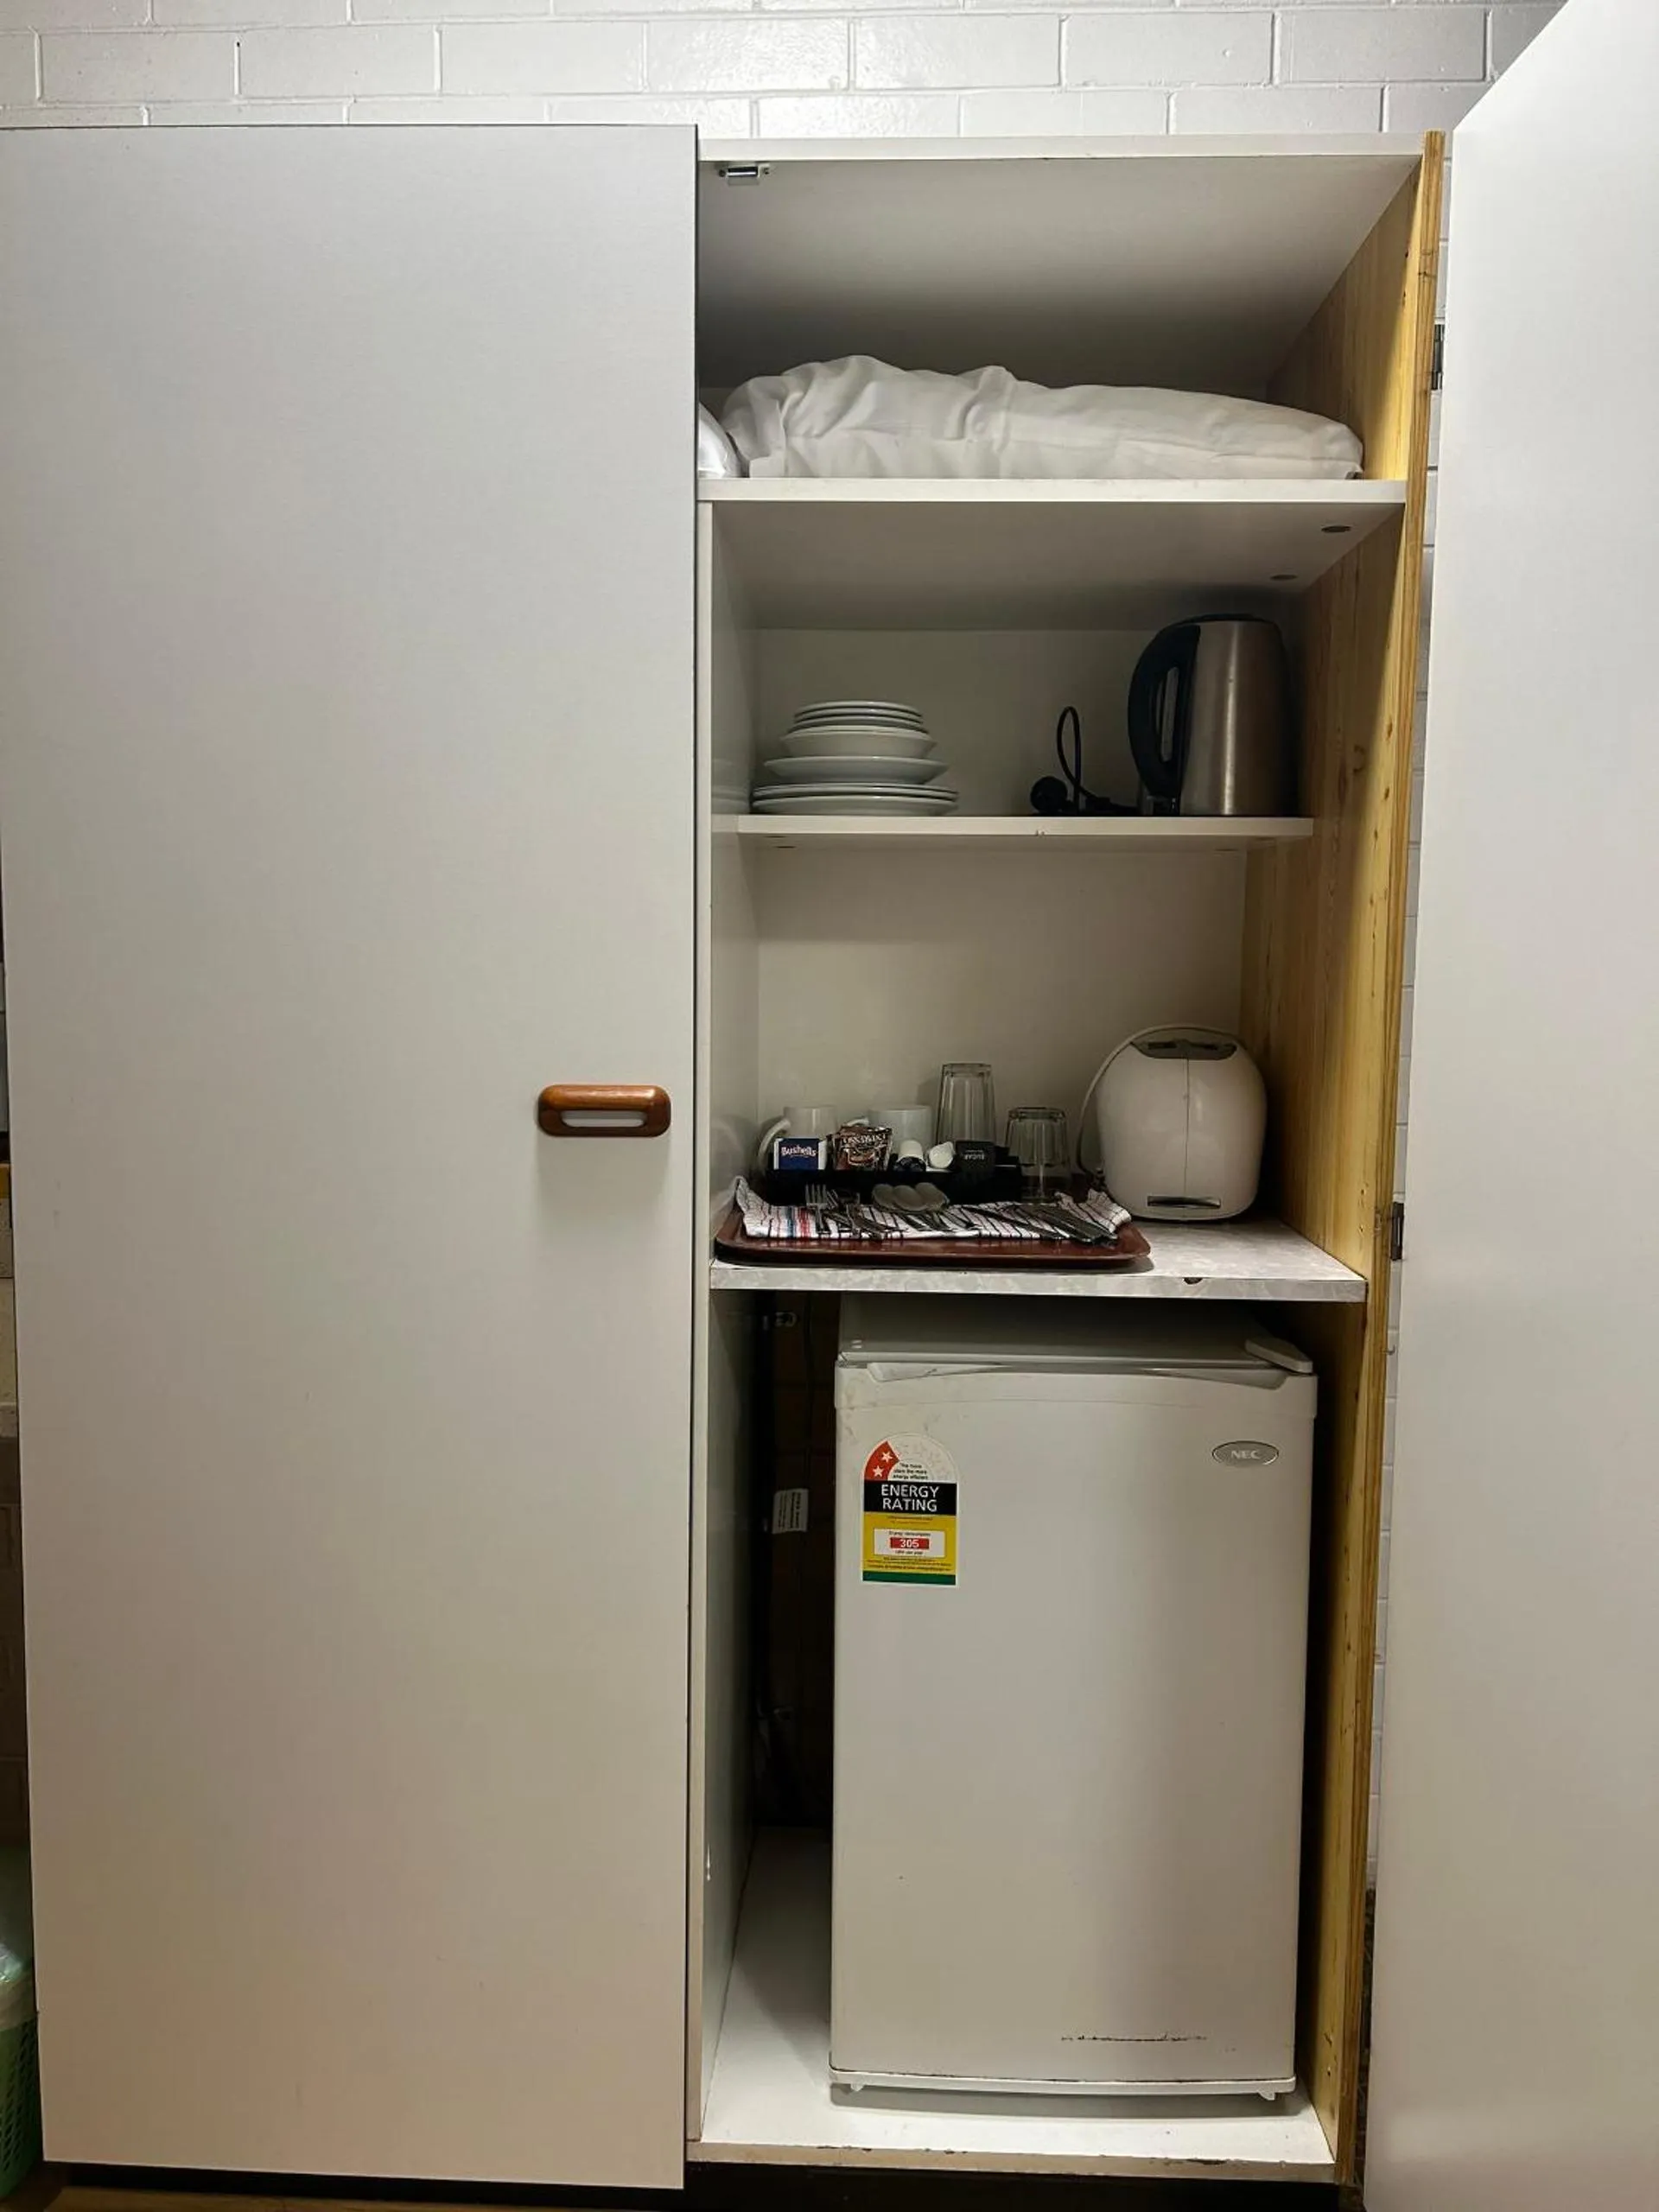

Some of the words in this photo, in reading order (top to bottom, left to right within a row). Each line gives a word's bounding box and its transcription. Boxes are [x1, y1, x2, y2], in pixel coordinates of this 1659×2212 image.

[781, 1146, 817, 1158] Bushells
[1230, 1450, 1261, 1459] NEC
[881, 1484, 939, 1498] ENERGY
[882, 1497, 938, 1512] RATING
[899, 1539, 920, 1548] 305
